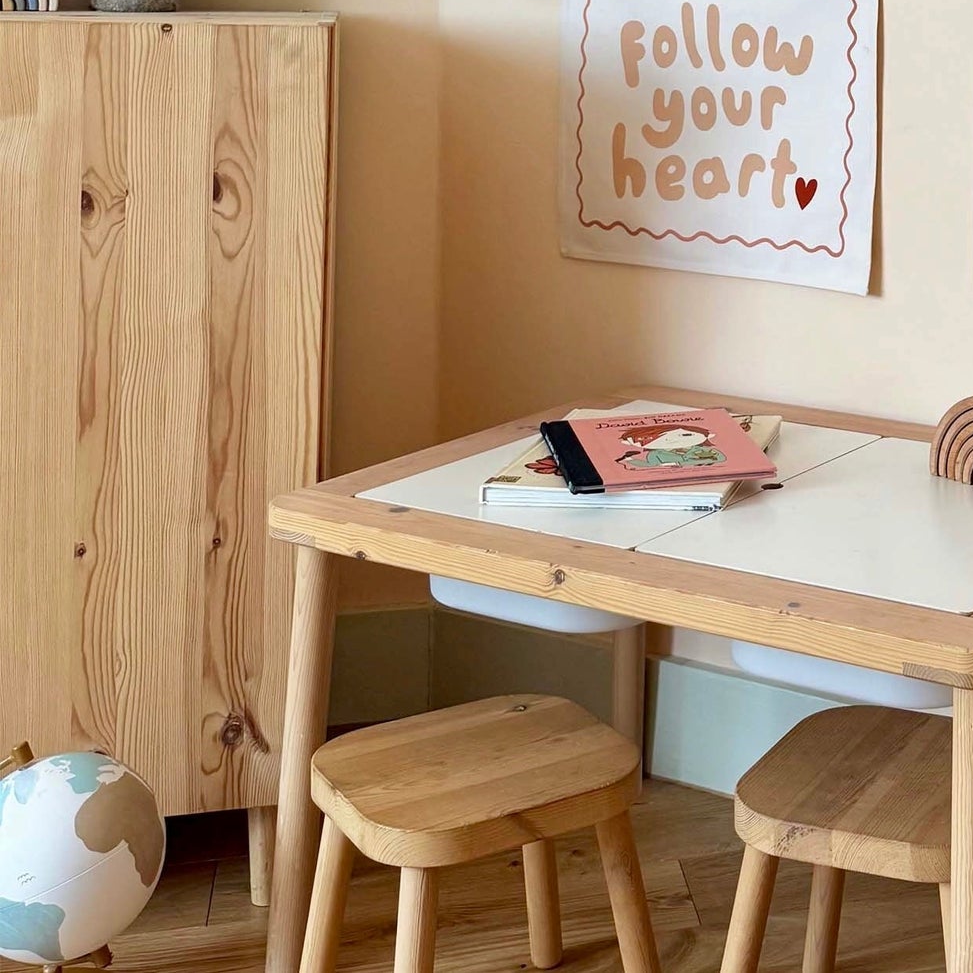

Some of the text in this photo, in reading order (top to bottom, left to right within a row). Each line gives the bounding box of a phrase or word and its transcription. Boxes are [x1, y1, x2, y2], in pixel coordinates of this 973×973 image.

[620, 1, 814, 88] follow
[641, 86, 787, 149] your
[612, 122, 798, 209] heart
